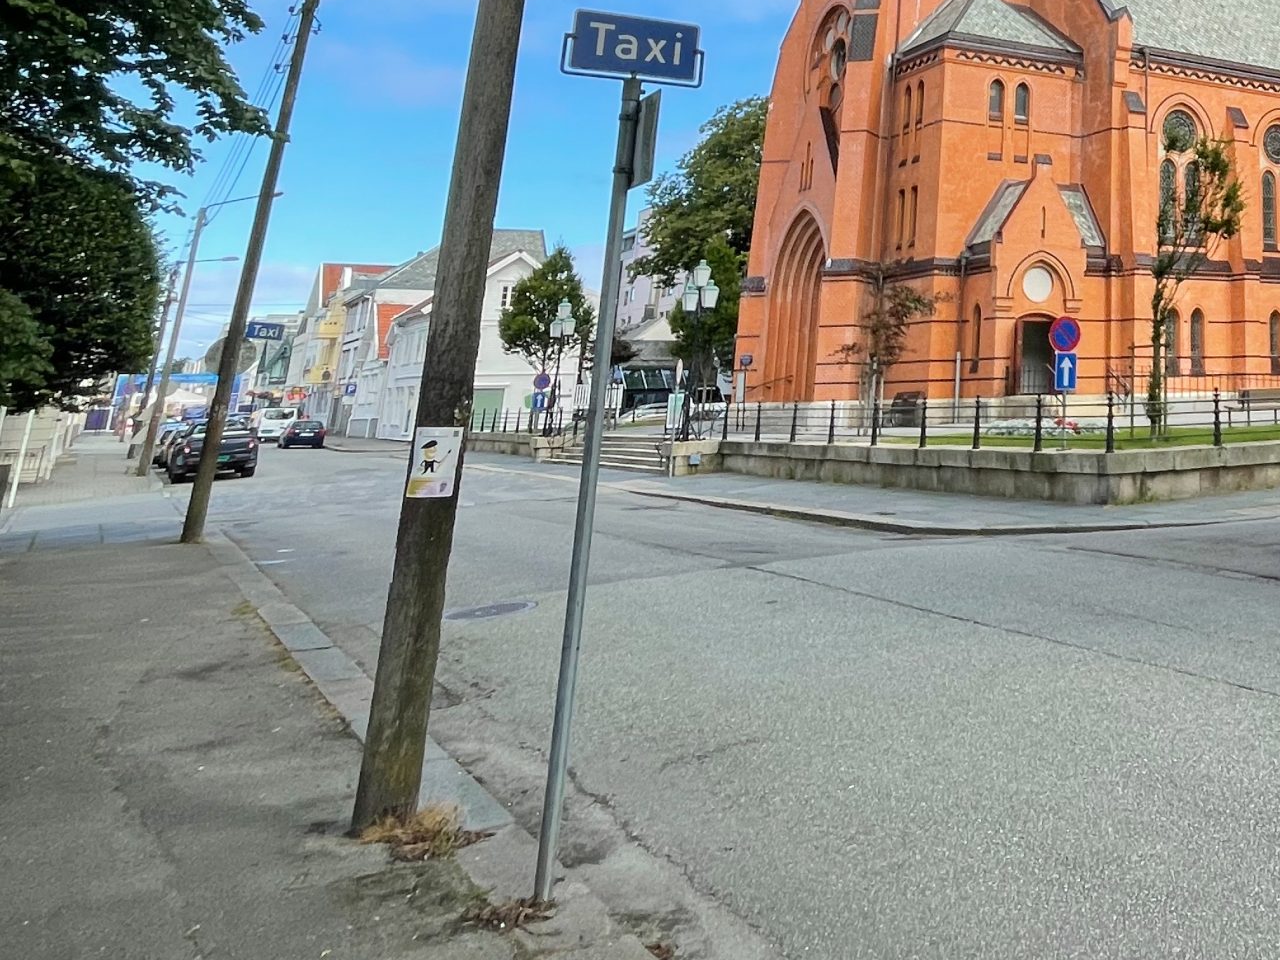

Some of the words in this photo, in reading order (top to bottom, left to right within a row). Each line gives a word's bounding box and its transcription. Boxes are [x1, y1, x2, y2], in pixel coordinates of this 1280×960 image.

[589, 21, 684, 66] Taxi
[253, 325, 281, 337] Taxi
[348, 385, 356, 393] P
